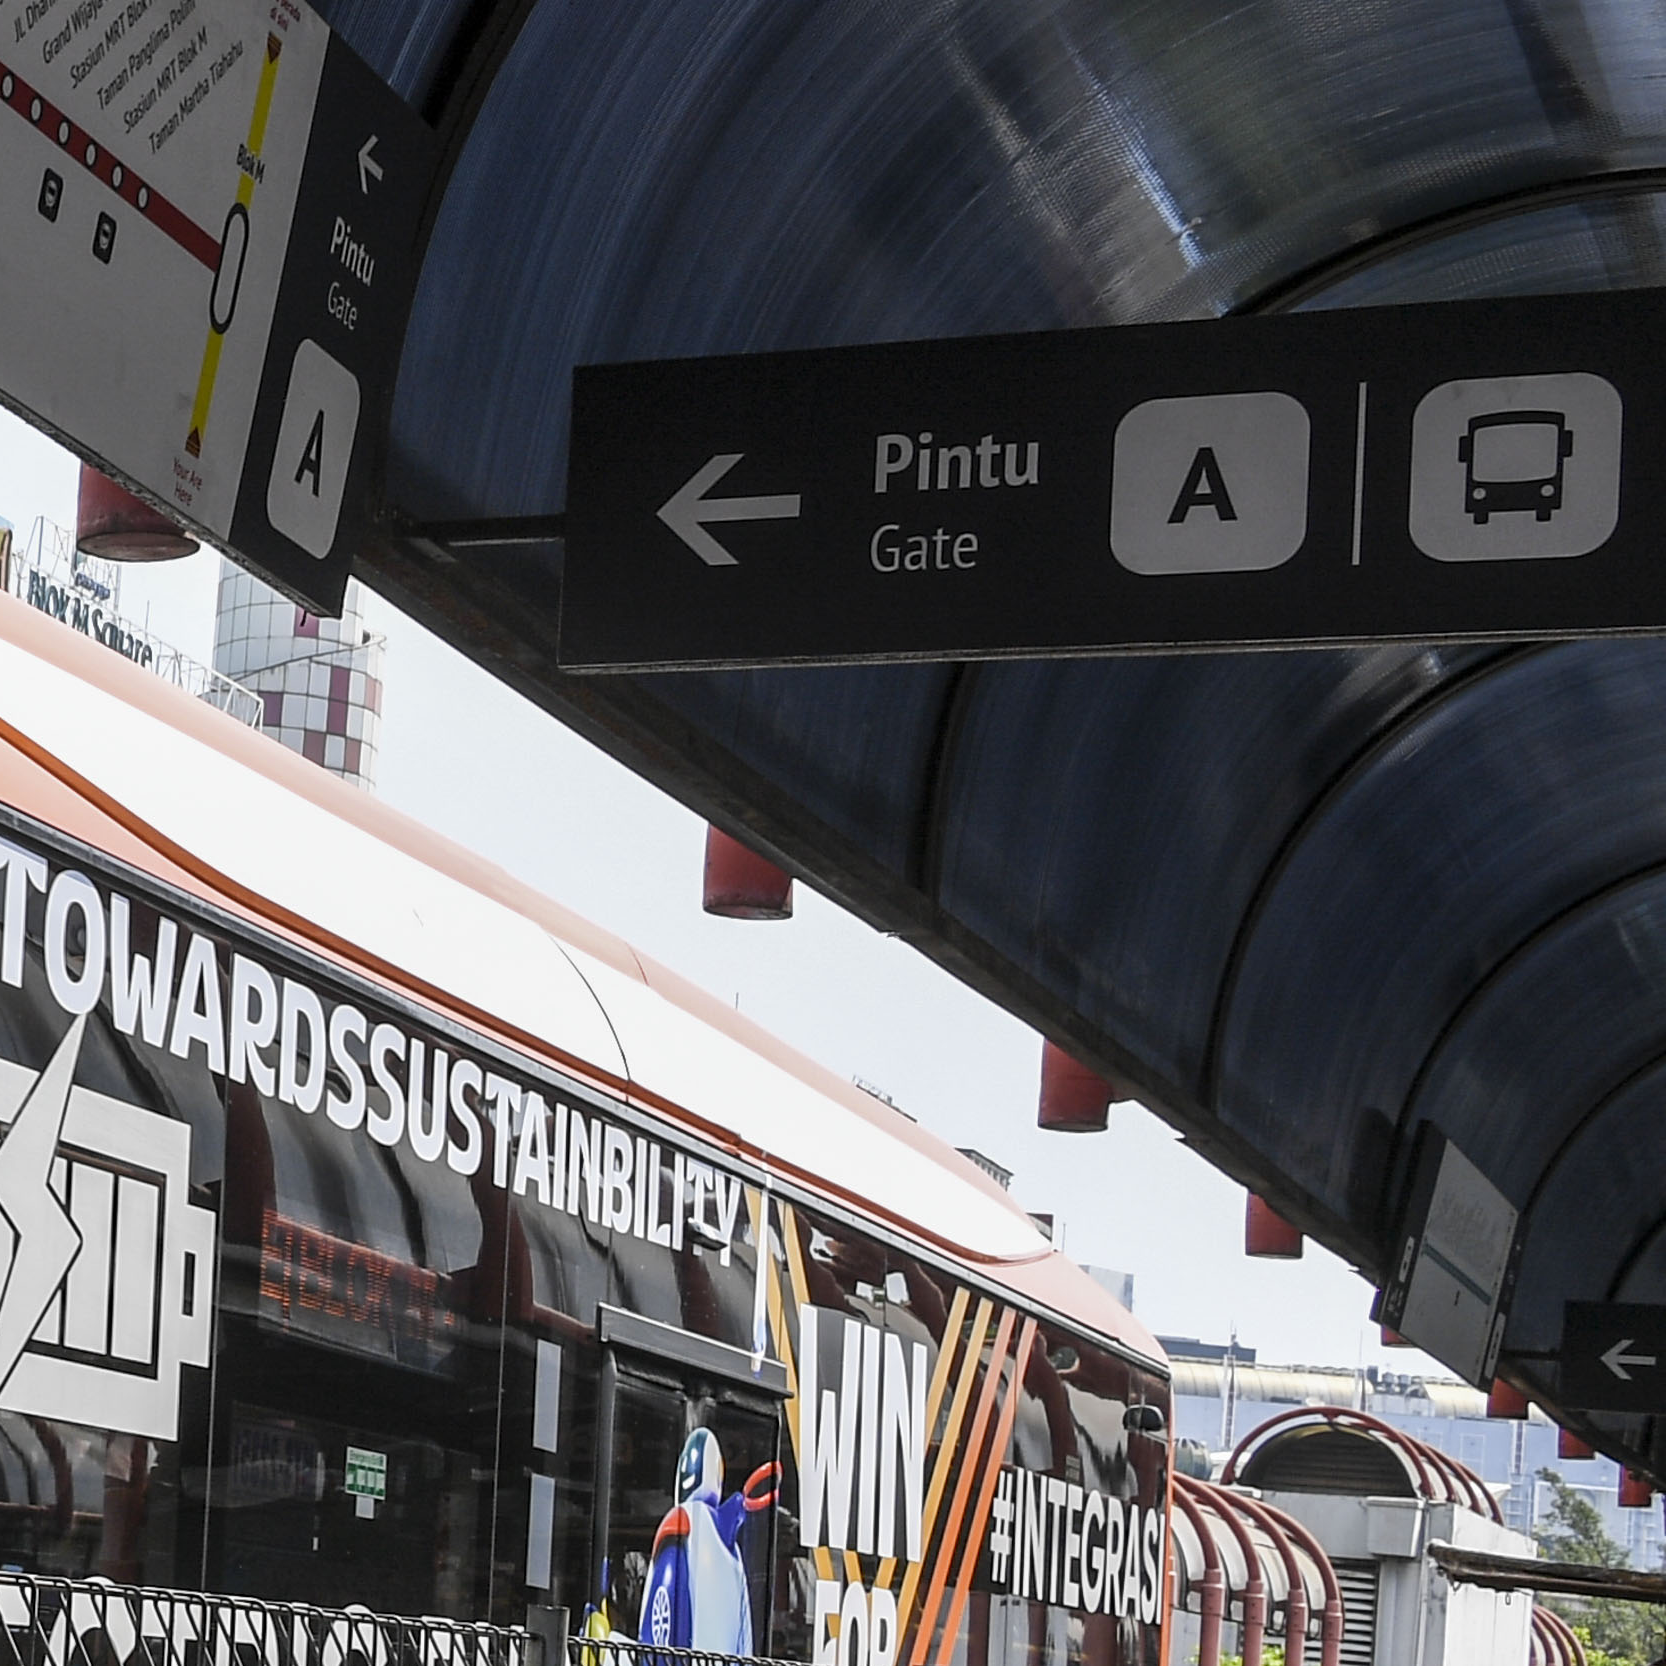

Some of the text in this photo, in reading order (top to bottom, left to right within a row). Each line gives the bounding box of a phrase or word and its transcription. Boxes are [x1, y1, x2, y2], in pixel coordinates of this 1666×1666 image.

[42, 20, 71, 64] Grand
[69, 42, 105, 89] Stasiun
[104, 12, 125, 52] MRT
[96, 67, 129, 110] Taman
[127, 23, 170, 78] Panglima
[123, 26, 208, 134] Stasiun MRT Blok M
[148, 40, 244, 155] Taman Martha Tiahahu
[236, 143, 265, 184] Blok M
[330, 215, 375, 287] Pintu
[327, 281, 357, 331] Gate
[293, 408, 325, 498] A
[870, 432, 1041, 496] Pintu
[1166, 446, 1239, 526] A
[174, 483, 193, 507] Here
[868, 522, 980, 574] Gate
[798, 1302, 928, 1564] WIN
[989, 1466, 1166, 1626] #INTEGRASI
